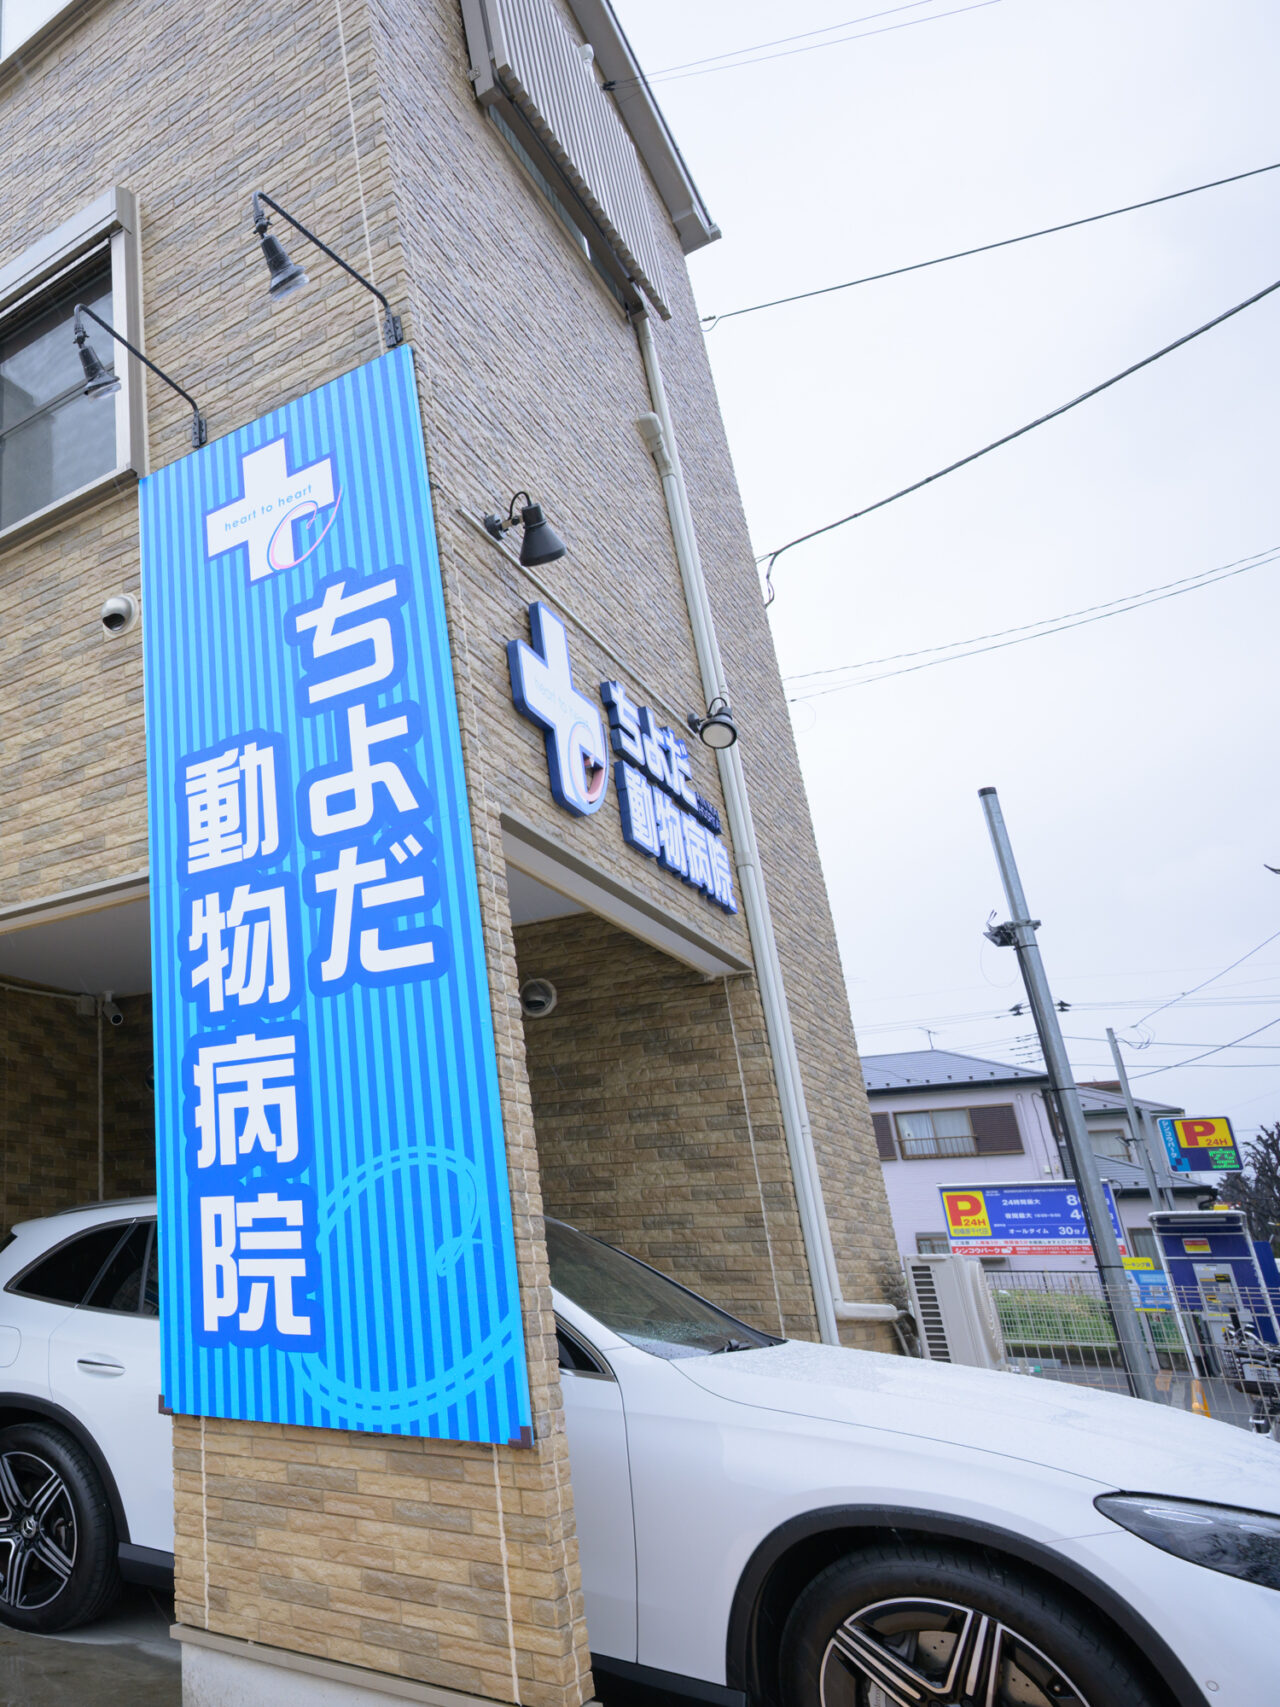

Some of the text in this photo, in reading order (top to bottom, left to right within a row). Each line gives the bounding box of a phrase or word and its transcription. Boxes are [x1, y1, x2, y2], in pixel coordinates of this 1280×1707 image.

[224, 484, 312, 532] heart to heart
[608, 682, 699, 812] ちよだ
[295, 578, 435, 982] ちよだ
[624, 762, 738, 915] 動物病院
[184, 741, 312, 1336] 動物病院
[1181, 1121, 1216, 1146] P
[1205, 1138, 1228, 1146] 24H
[945, 1194, 983, 1227] P
[963, 1218, 987, 1227] 24H
